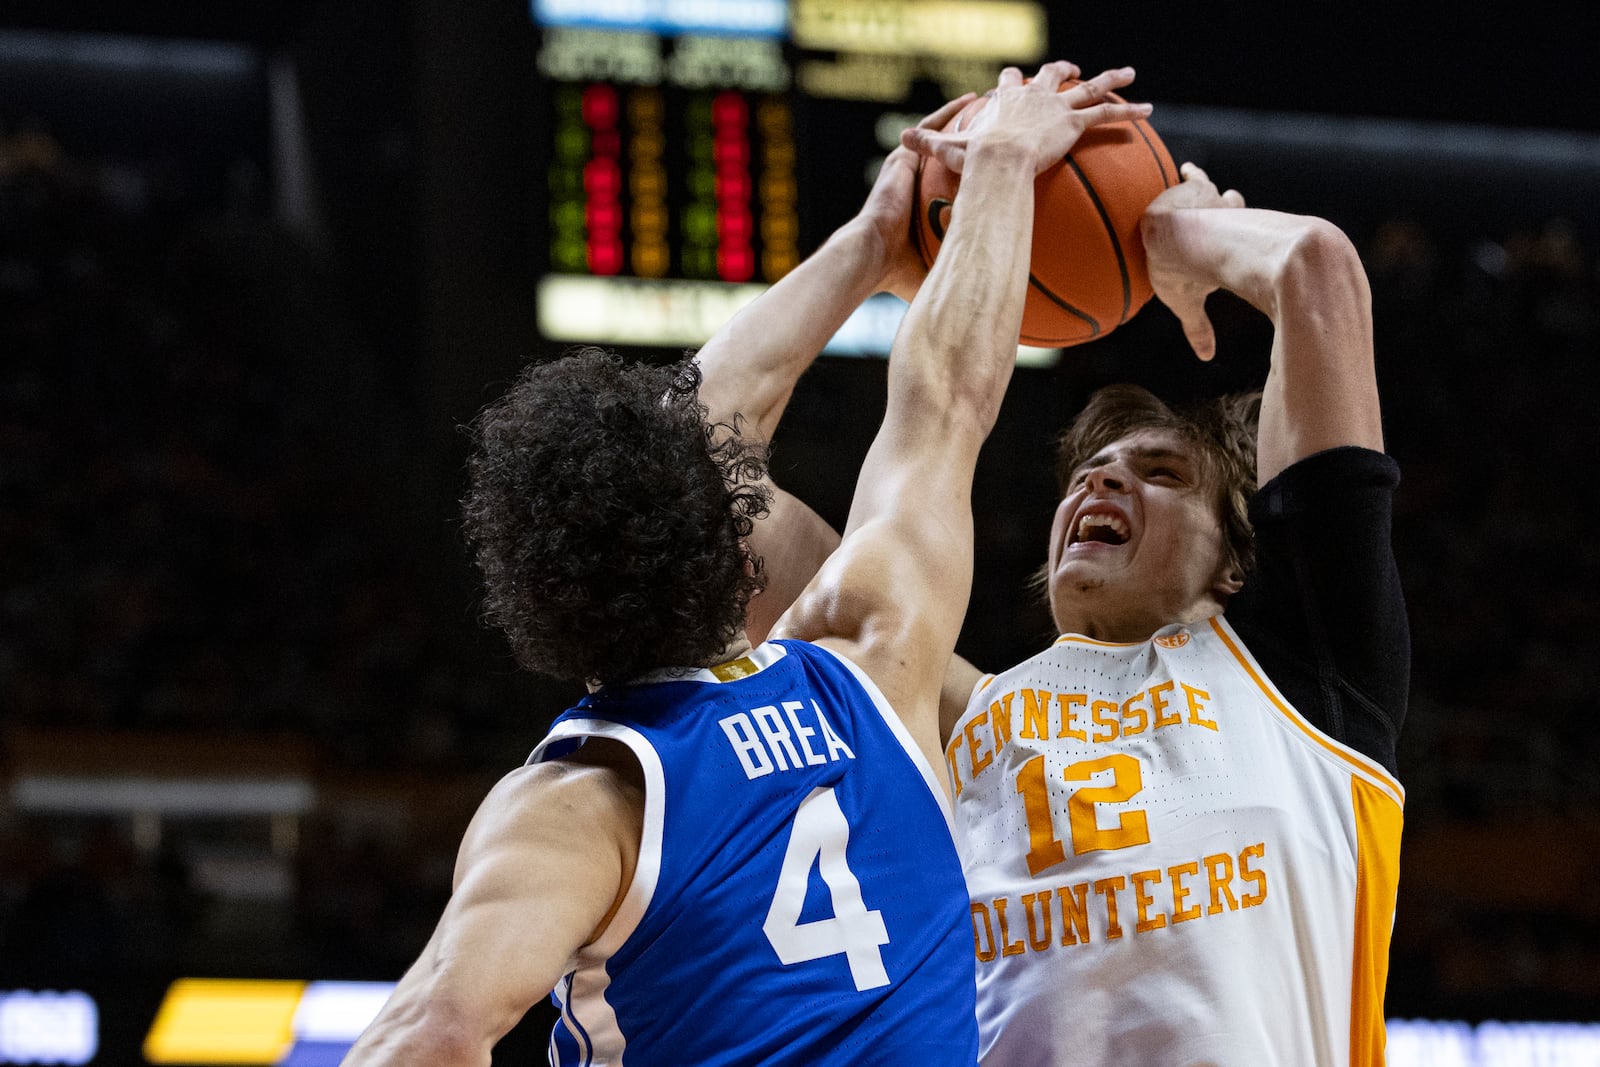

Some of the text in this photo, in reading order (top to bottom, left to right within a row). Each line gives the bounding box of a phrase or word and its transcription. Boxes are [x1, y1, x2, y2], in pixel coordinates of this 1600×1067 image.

[719, 699, 856, 780] BREA
[947, 680, 1219, 799] TENNESSEE
[1016, 753, 1151, 879] 12
[762, 786, 891, 992] 4
[970, 842, 1268, 963] OLUNTEERS
